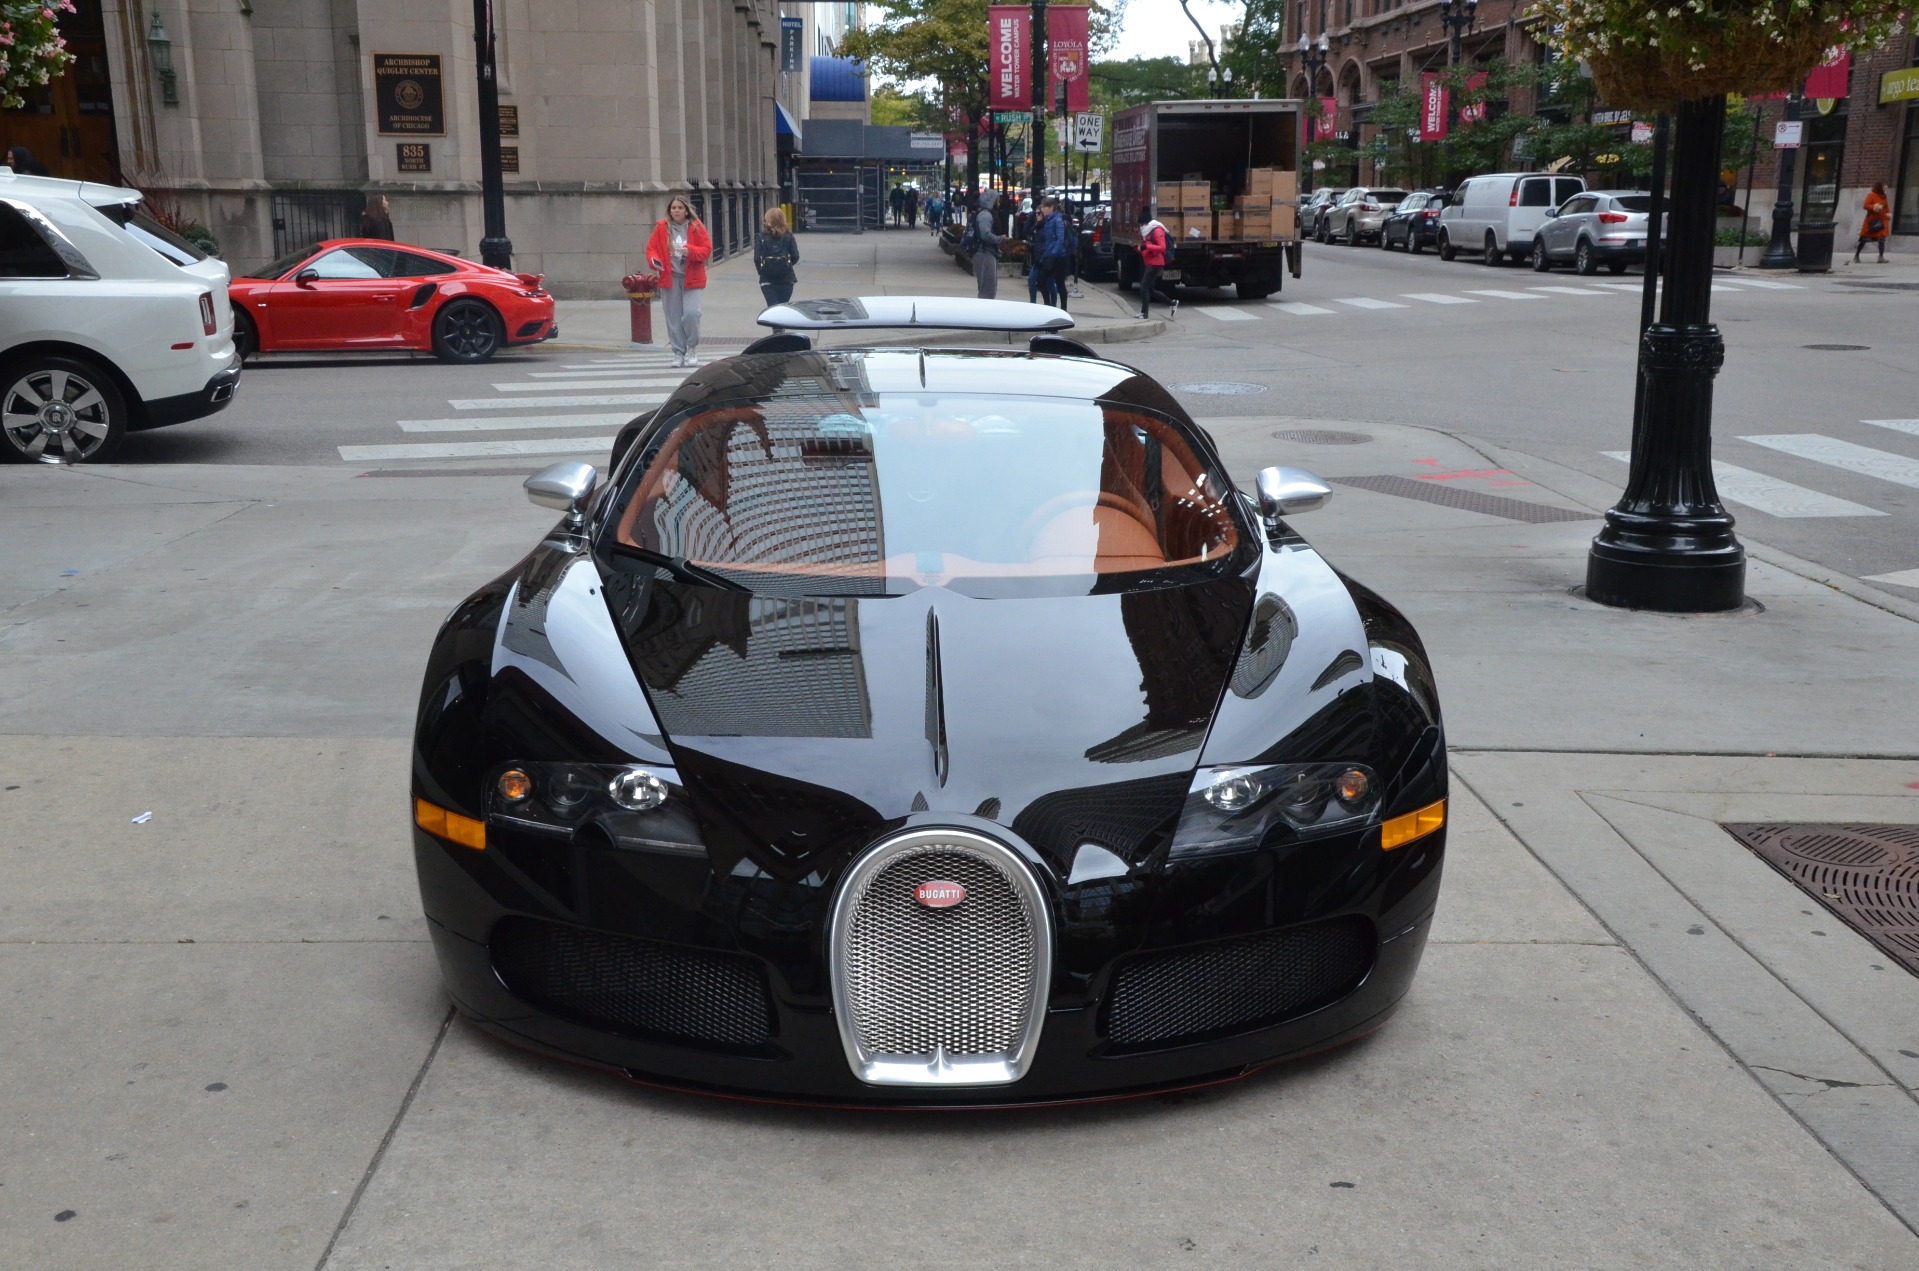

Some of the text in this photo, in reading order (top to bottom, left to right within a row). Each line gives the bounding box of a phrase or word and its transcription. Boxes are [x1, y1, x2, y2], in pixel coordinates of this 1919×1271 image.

[1053, 40, 1083, 48] LOYOLA
[1000, 18, 1013, 98] WELCOME
[376, 67, 409, 75] QUIGLEY
[1427, 82, 1437, 132] WELCOM
[1001, 113, 1021, 122] RUSH
[1079, 116, 1100, 127] ONE
[1078, 127, 1100, 137] WAY
[402, 145, 424, 157] 835
[919, 889, 960, 899] BUGATTI
